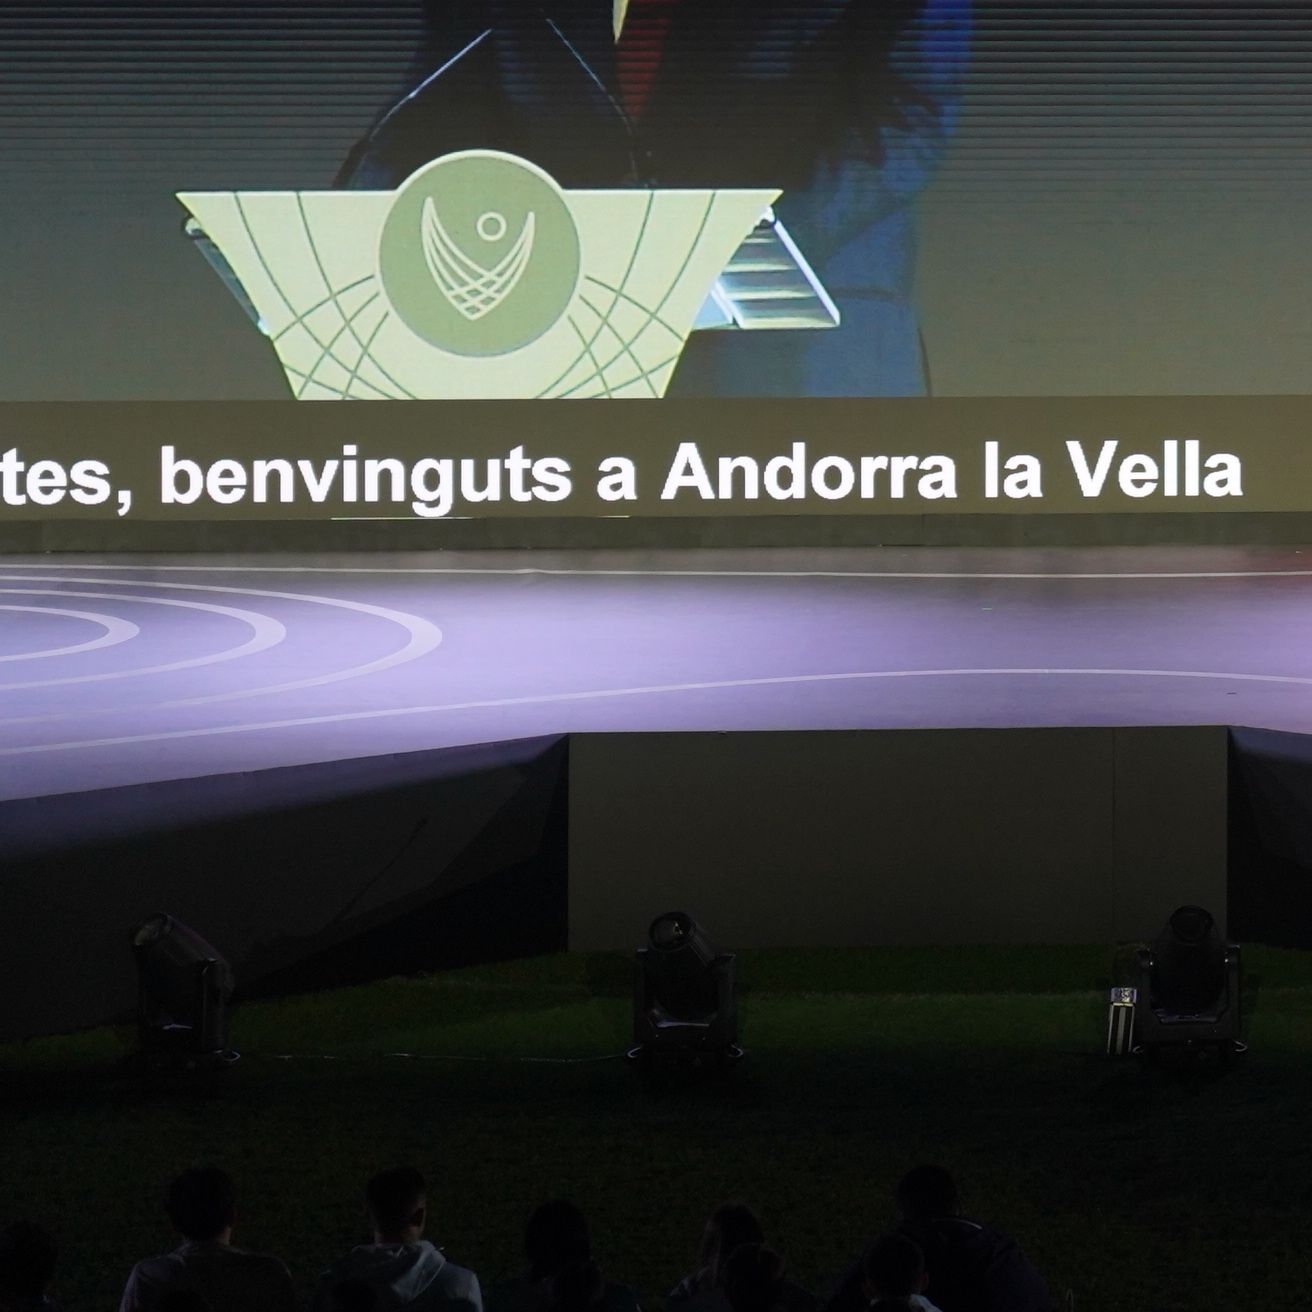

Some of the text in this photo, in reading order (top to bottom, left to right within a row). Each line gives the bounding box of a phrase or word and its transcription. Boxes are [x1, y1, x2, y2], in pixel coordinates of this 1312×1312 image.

[161, 444, 572, 517] benvinguts
[597, 456, 638, 501] a
[660, 441, 958, 500] Andorra
[985, 440, 1043, 499] la
[1065, 439, 1244, 498] Vella
